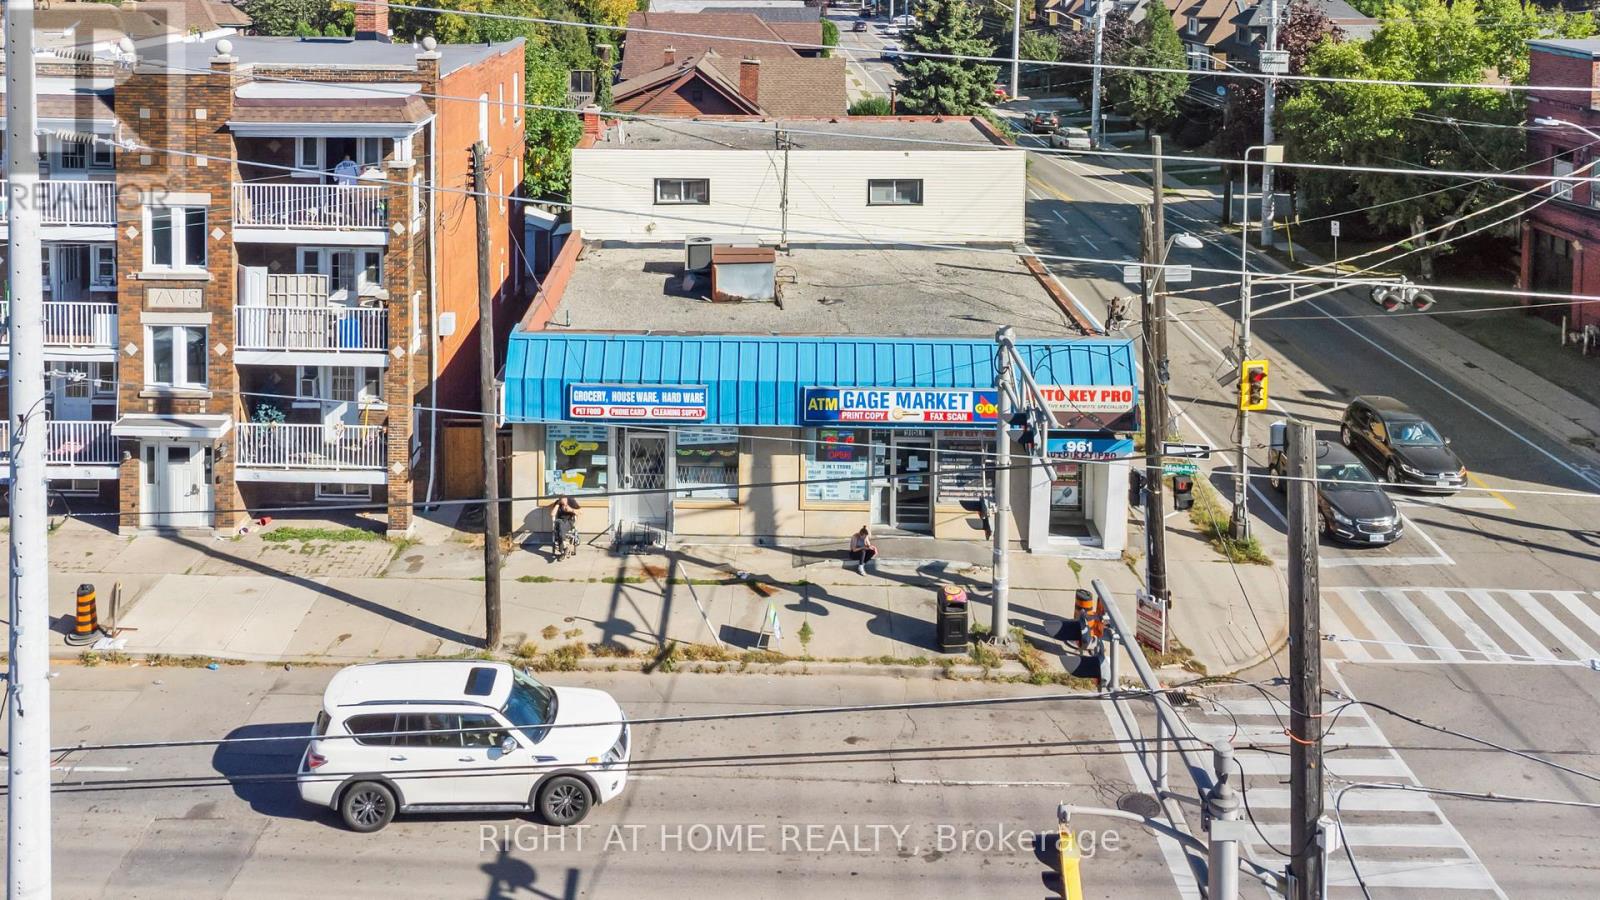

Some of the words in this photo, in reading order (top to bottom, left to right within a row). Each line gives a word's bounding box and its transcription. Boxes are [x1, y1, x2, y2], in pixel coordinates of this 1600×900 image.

[573, 390, 608, 403] GROCERY,
[662, 391, 681, 403] HARD
[682, 391, 705, 404] WARE
[843, 391, 890, 409] GAGE
[896, 391, 969, 411] MARKET
[1069, 390, 1097, 402] KEY
[1101, 390, 1132, 402] PRO
[808, 397, 838, 411] ATM
[842, 411, 863, 420] PRINT
[865, 411, 885, 421] COPY
[930, 412, 944, 421] FAX
[947, 412, 968, 421] SCAN
[1066, 441, 1093, 452] 961
